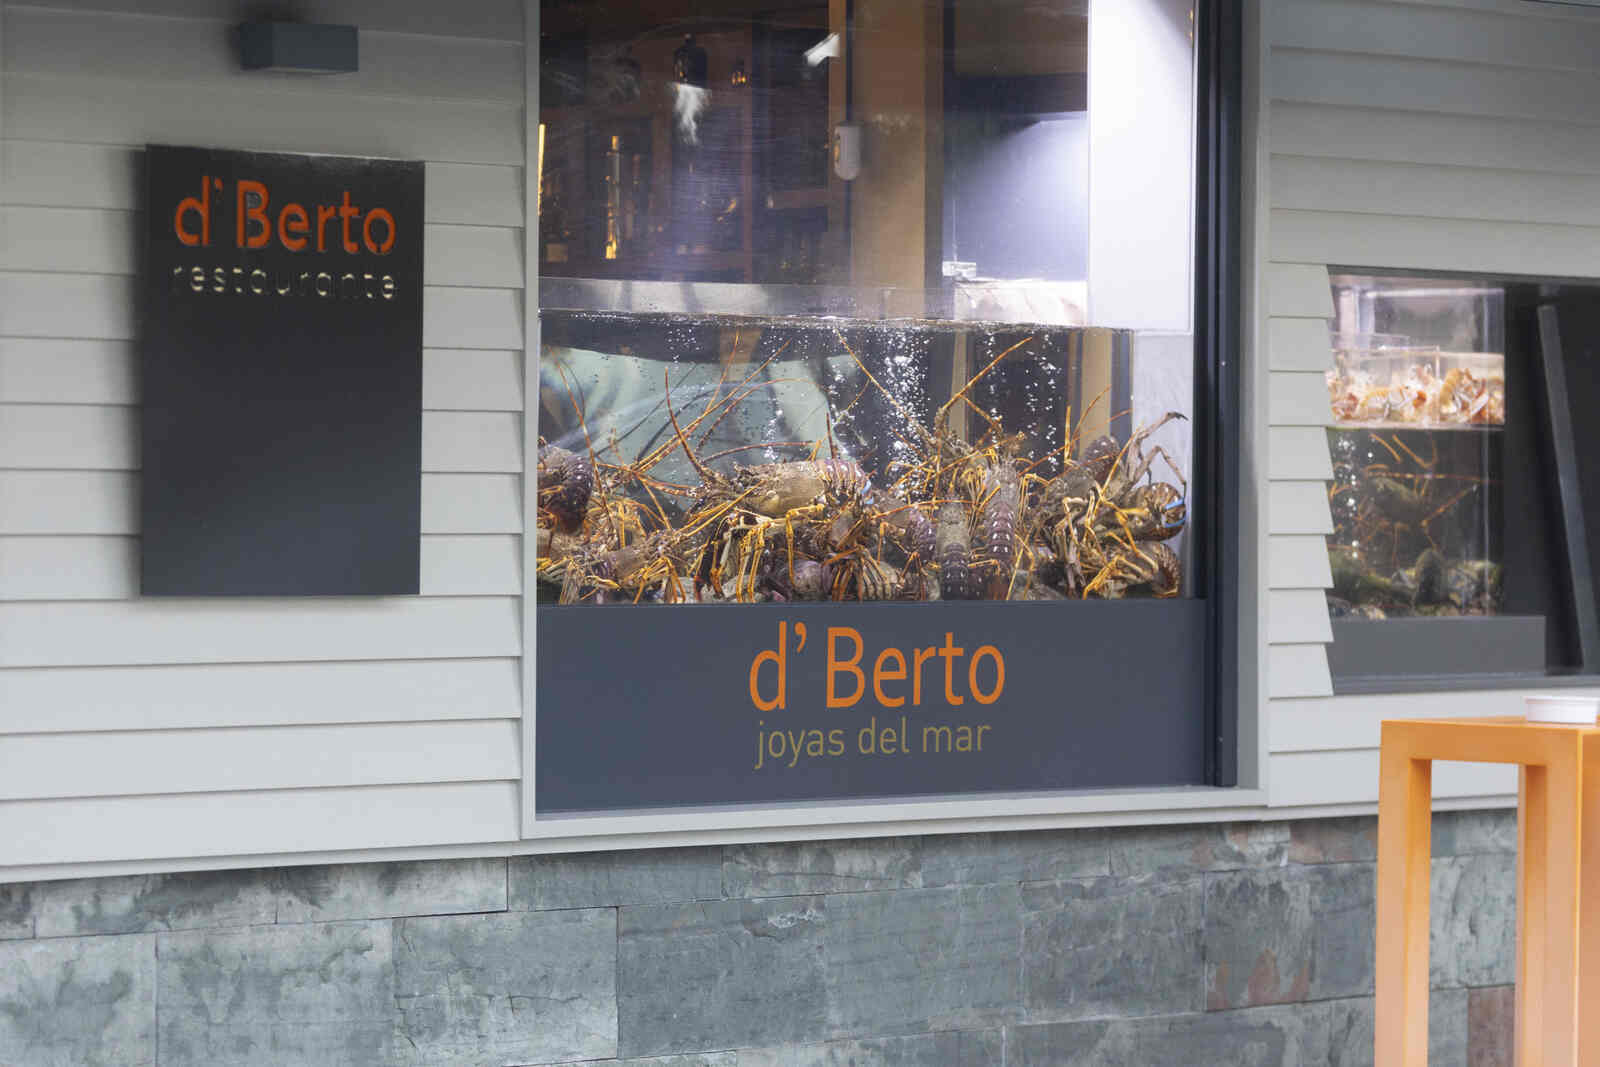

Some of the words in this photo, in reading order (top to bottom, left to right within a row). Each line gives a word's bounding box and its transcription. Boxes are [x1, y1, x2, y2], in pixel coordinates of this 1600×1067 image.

[236, 179, 397, 255] Berto
[825, 626, 1006, 709] Berto
[753, 718, 846, 771] joyas
[857, 716, 911, 755] del
[921, 723, 992, 754] mar
